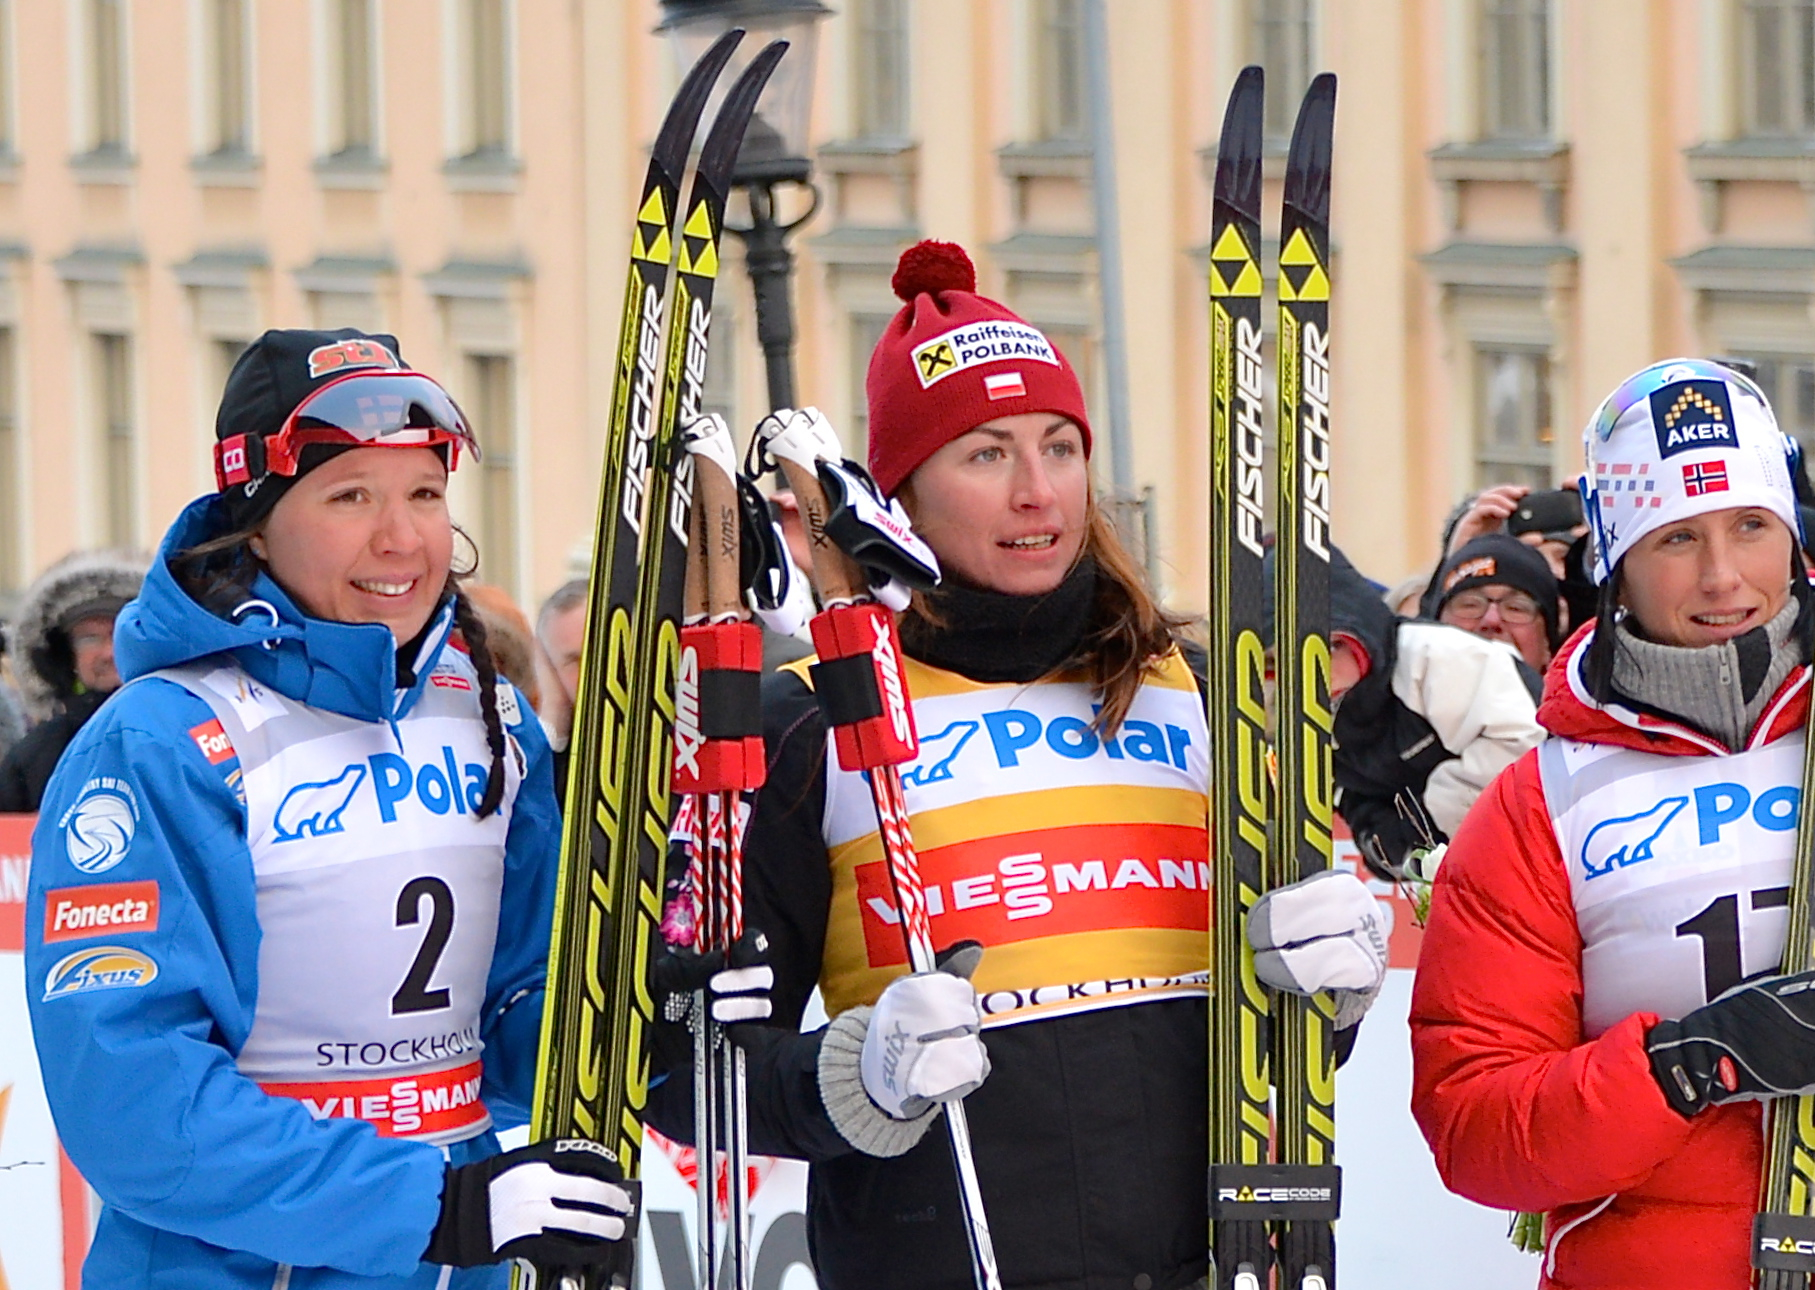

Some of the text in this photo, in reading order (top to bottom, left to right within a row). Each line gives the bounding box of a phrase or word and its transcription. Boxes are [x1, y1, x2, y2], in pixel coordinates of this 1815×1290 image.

[953, 325, 1044, 347] Raiffeisen
[961, 343, 1051, 364] POLBANK
[623, 284, 664, 535] FISCHER
[670, 297, 711, 547] FISHER
[1236, 316, 1263, 558] FISCHER
[1303, 321, 1330, 563] FISCHER
[1667, 423, 1730, 447] AKER
[981, 703, 1193, 771] Polar
[53, 898, 149, 932] Fonecta
[392, 876, 455, 1016] 2
